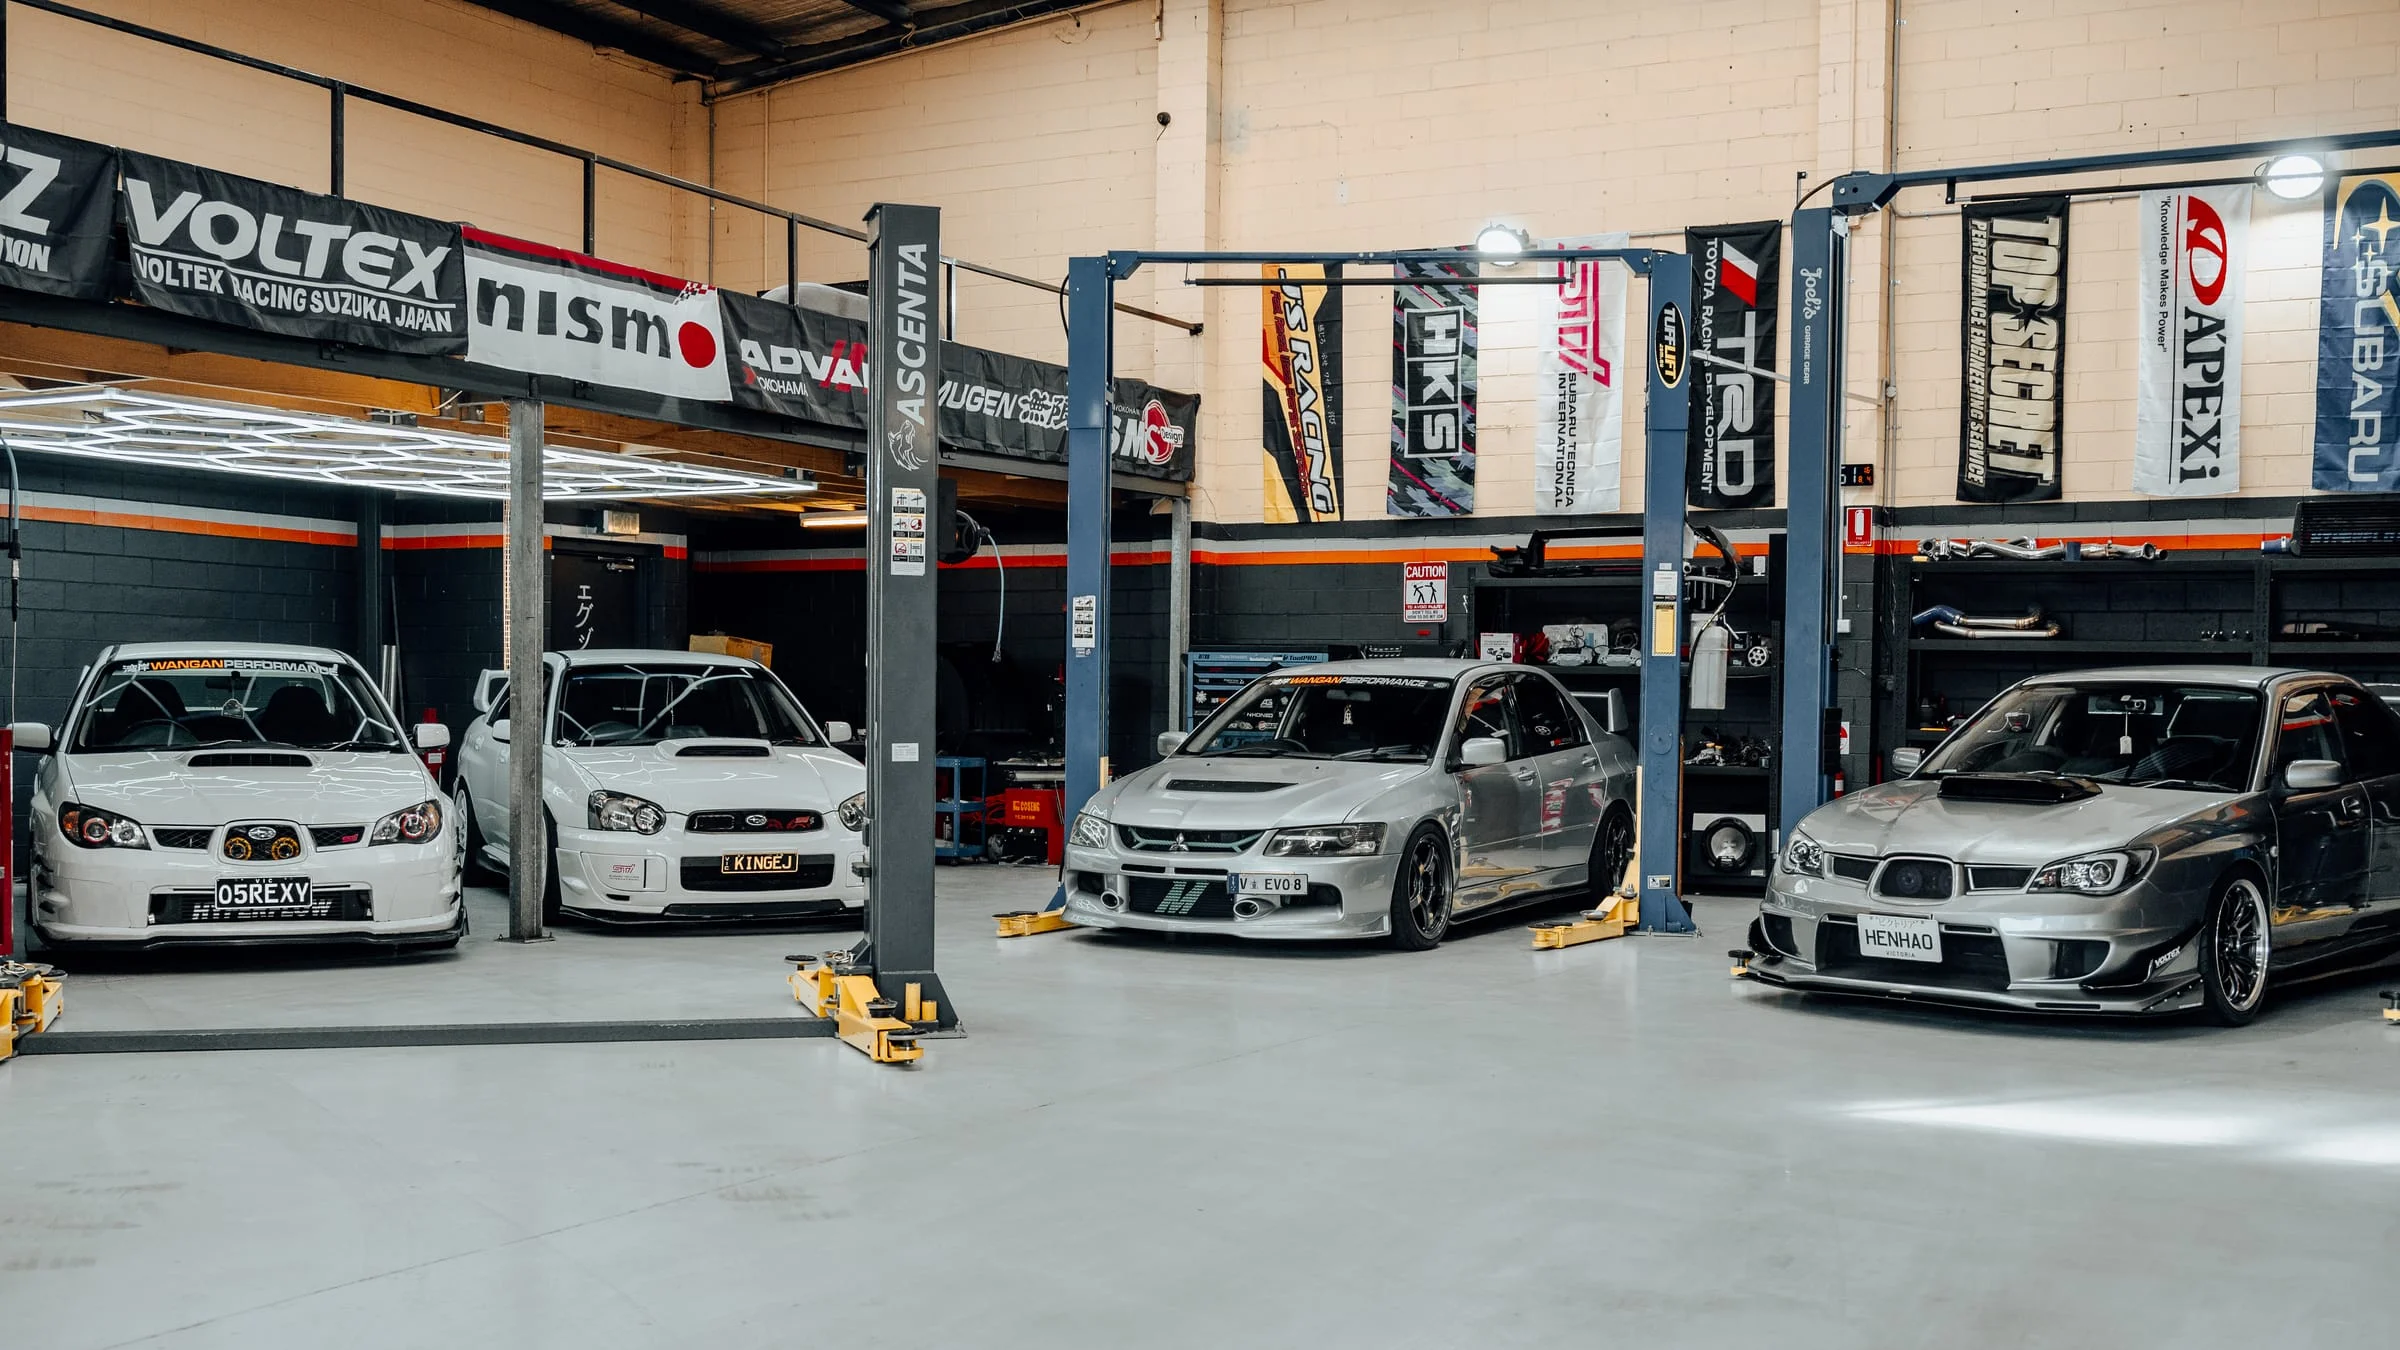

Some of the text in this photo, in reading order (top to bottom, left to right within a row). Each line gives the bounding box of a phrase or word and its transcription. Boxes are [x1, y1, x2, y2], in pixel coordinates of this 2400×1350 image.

[126, 177, 452, 300] VOLTEX
[134, 253, 452, 333] VOLTEX RACING SUZUKA JAPAN
[1702, 238, 1719, 301] TOYOTA
[2156, 195, 2171, 353] "Knowledge Makes Power"
[896, 243, 928, 427] ASCENTA
[1422, 314, 1457, 450] HKS
[1799, 266, 1823, 385] Joel's GARAGE GEAR
[1967, 220, 1988, 486] PERFORMANCE ENGINEERING SERVICE
[1987, 216, 2062, 485] TOP SECRET
[2348, 259, 2388, 482] SUBARU
[1289, 338, 1336, 514] RACING
[1554, 373, 1567, 508] INTERNATIONAL
[1565, 372, 1577, 508] SUBARU TECNICA
[1700, 372, 1714, 494] DEVELOPMENT
[1715, 311, 1756, 497] TRD
[1406, 565, 1446, 578] CAUTION
[734, 855, 793, 871] KINGEJ
[1240, 878, 1248, 890] V
[1865, 928, 1934, 951] HENHAO
[2154, 945, 2181, 969] VOLTEX
